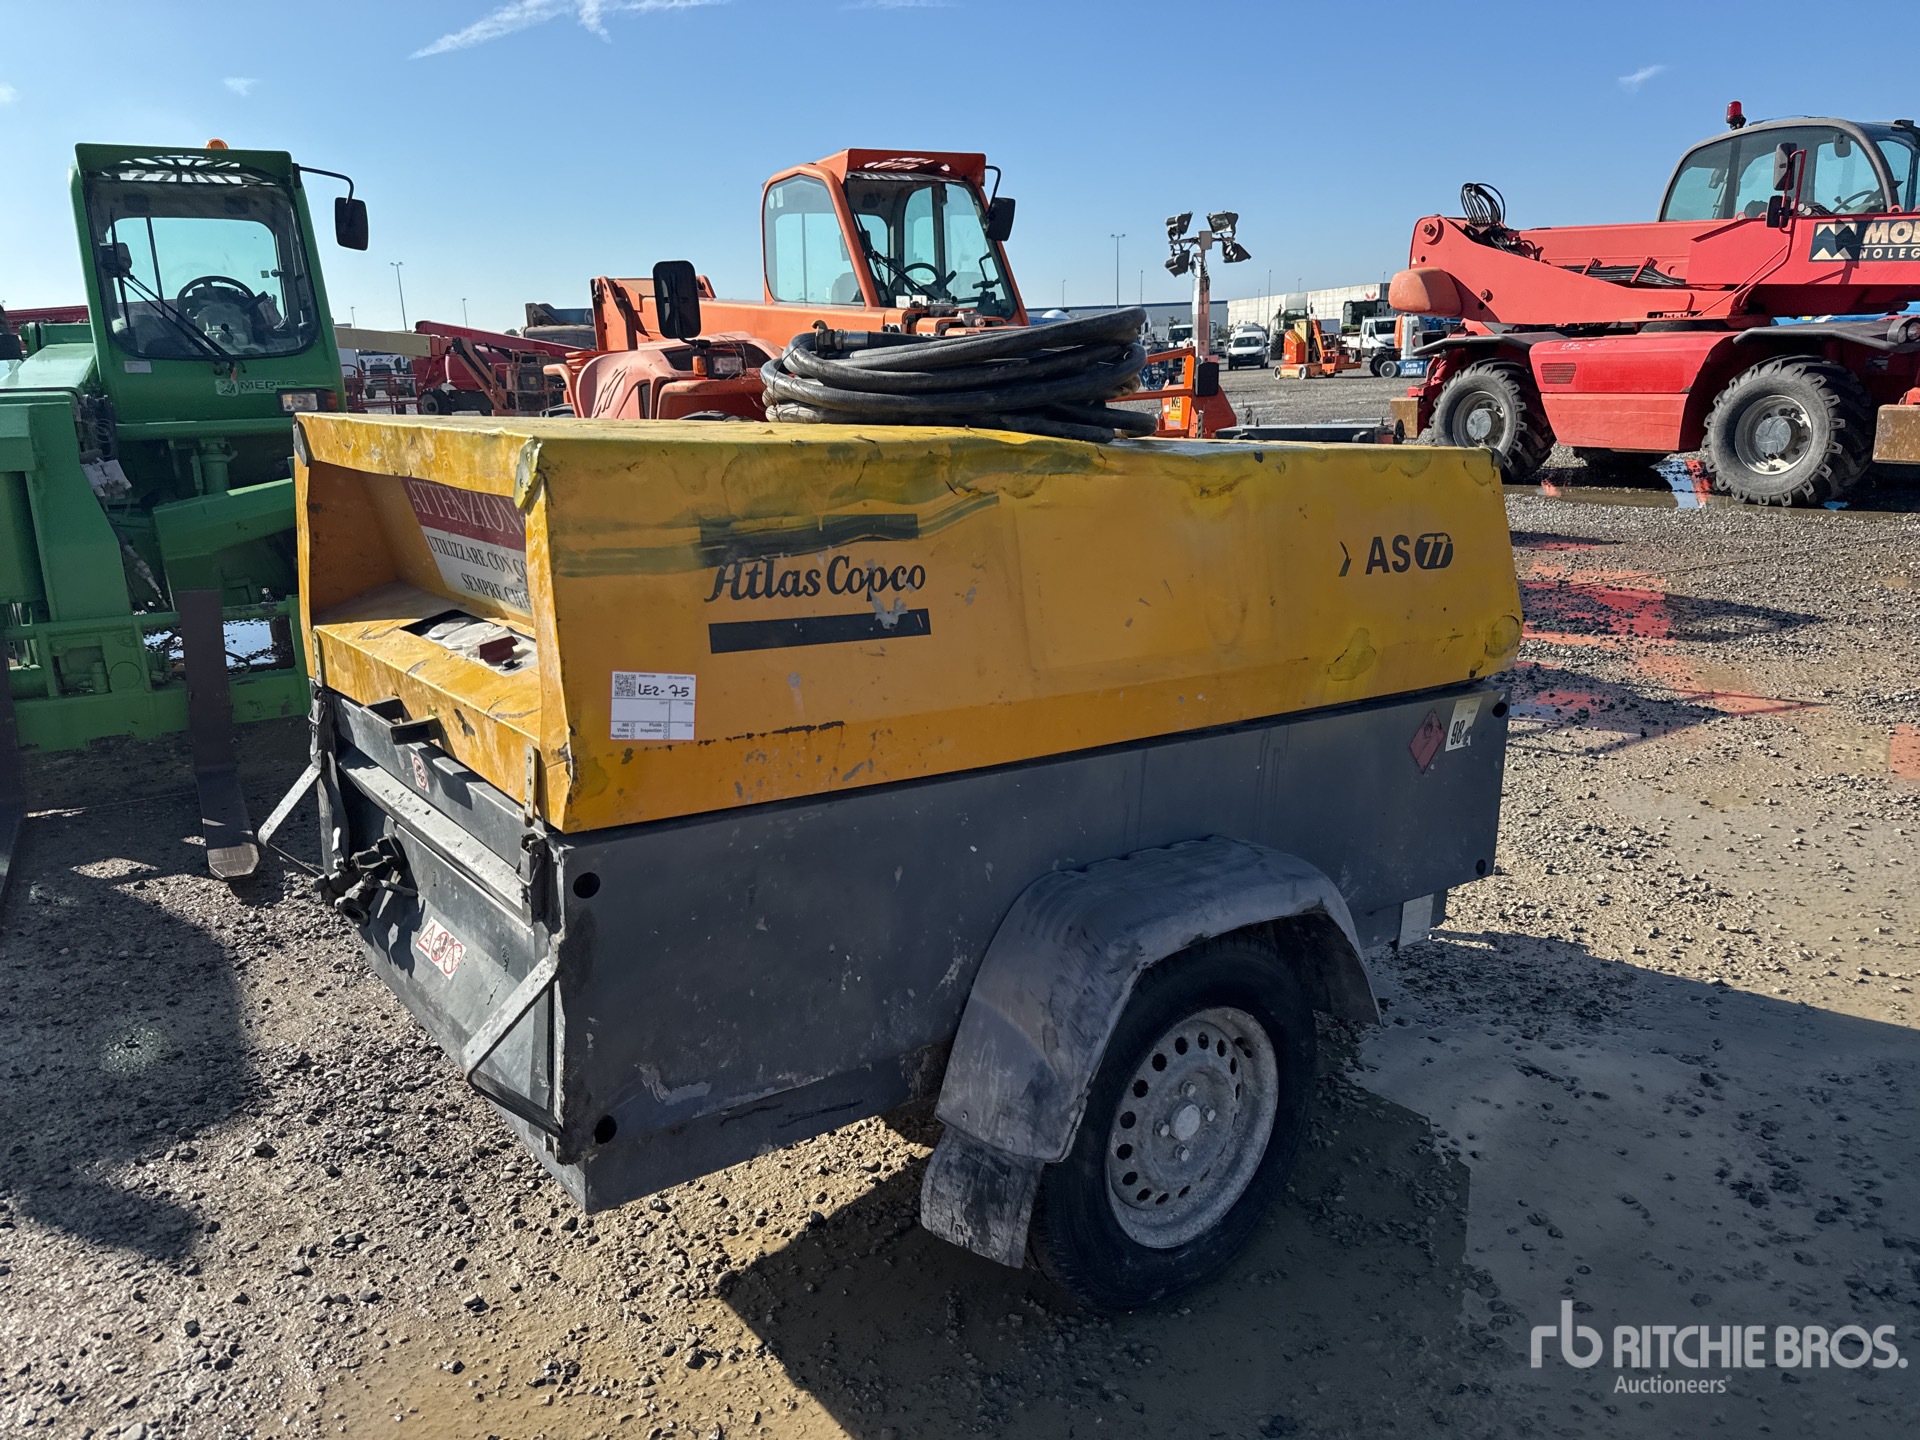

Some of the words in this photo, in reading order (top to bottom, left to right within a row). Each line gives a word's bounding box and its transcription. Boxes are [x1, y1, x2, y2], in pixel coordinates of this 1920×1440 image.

[408, 480, 526, 536] ATTENZION
[426, 535, 489, 567] UTILIZZARE
[487, 551, 514, 574] CON
[513, 559, 528, 581] CO
[704, 558, 821, 602] Atlas
[826, 555, 926, 602] Copco
[461, 572, 505, 601] SEMPRE
